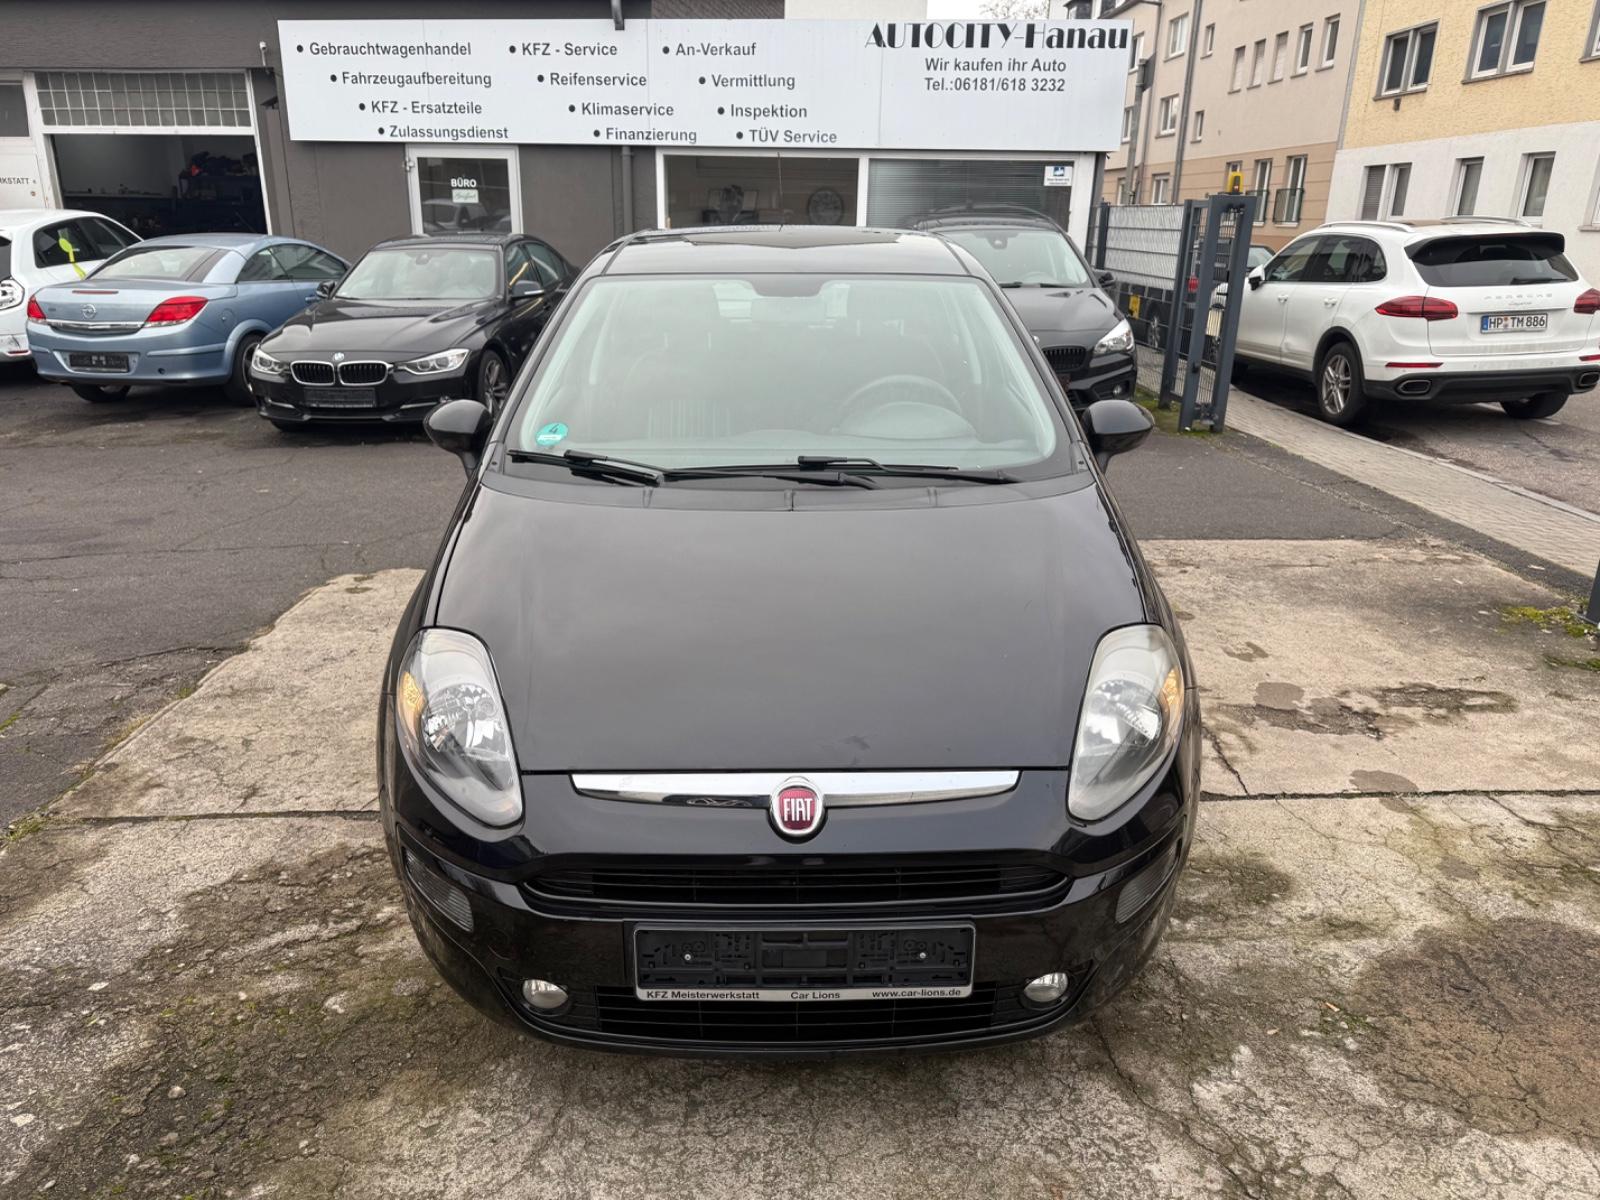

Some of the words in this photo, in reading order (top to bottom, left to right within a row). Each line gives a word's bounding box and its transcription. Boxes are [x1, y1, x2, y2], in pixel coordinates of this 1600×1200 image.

[865, 22, 1129, 49] AUTOCITY-Hanau
[310, 42, 471, 58] Gebrauchtwagenhandel
[522, 43, 550, 55] KFZ
[565, 43, 617, 55] Service
[676, 43, 756, 55] An-Verkauf
[926, 58, 949, 70] Wir
[954, 58, 1002, 71] kaufen
[1008, 58, 1027, 71] ihr
[1031, 59, 1066, 72] Auto
[343, 72, 491, 88] Fahrzeugaufbereitung
[550, 73, 646, 86] Reifenservice
[712, 75, 794, 90] Vermittlung
[925, 78, 1025, 91] Tel.:06181/618
[1032, 78, 1065, 91] 3232
[372, 101, 398, 113] KFZ
[412, 101, 481, 113] Ersatzteile
[582, 103, 673, 115] Klimaservice
[731, 104, 807, 120] Inspektion
[389, 126, 508, 141] Zulassungsdienst
[606, 128, 696, 143] Finanzierung
[750, 128, 778, 142] TÜV
[784, 130, 836, 142] Service
[451, 177, 477, 188] BÜRO
[1489, 317, 1503, 329] HP
[1510, 317, 1524, 328] TM
[1526, 316, 1545, 327] 886
[783, 798, 813, 821] FIAT
[647, 991, 668, 999] KFZ
[671, 991, 760, 999] Meisterwerkstatt
[790, 991, 810, 1000] Car
[812, 991, 841, 1000] Lions
[872, 989, 961, 998] www.car-lions.de
